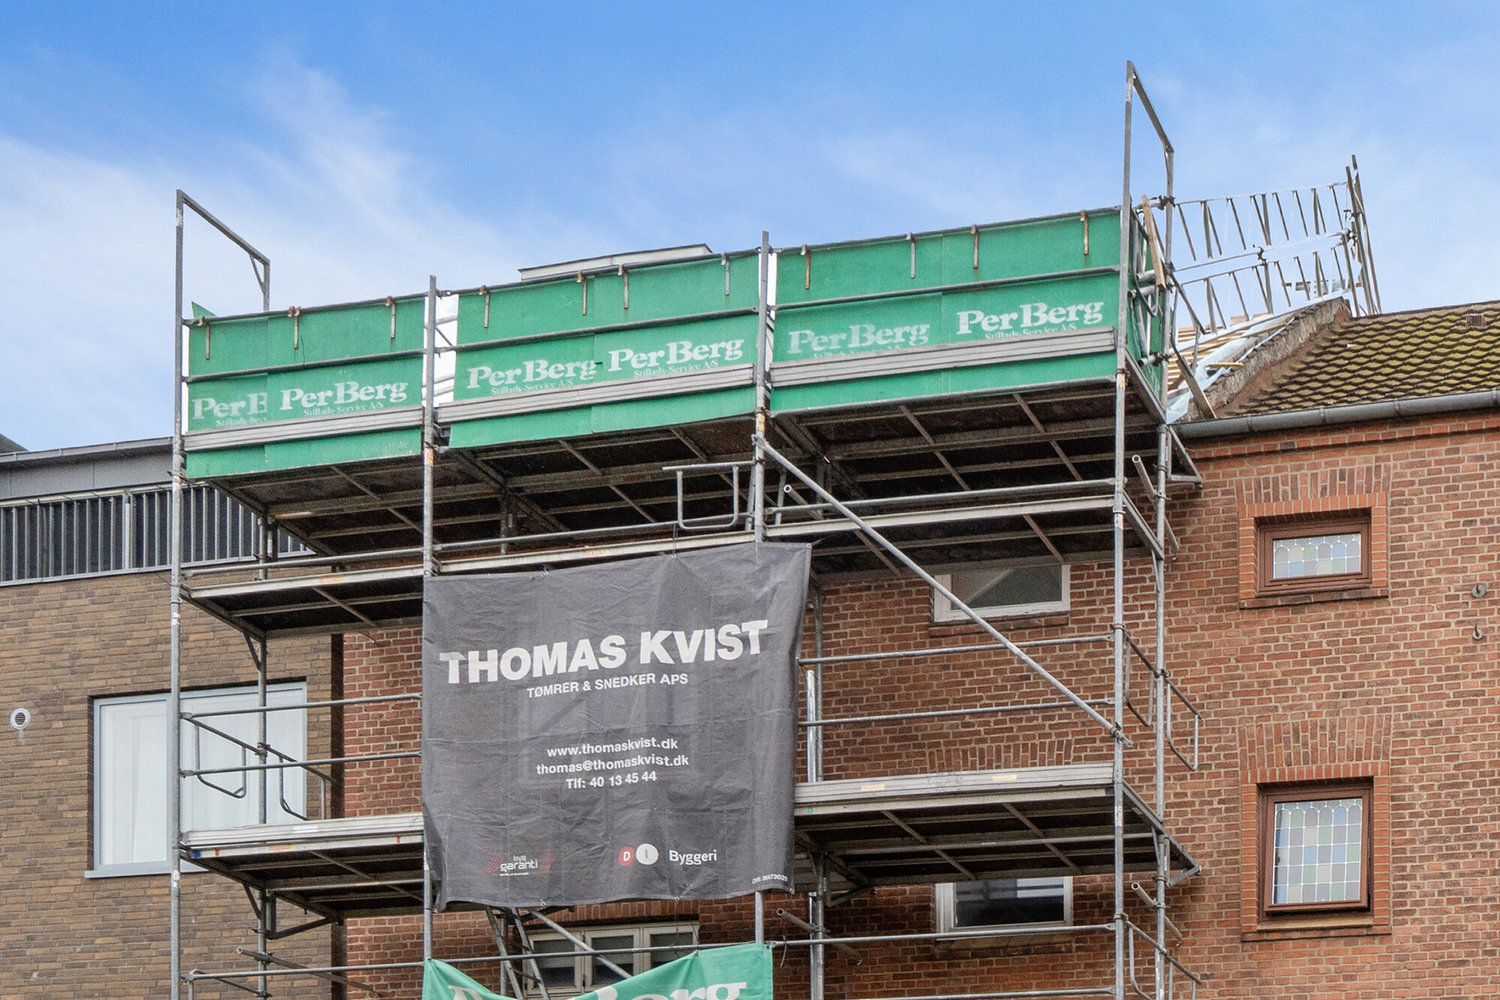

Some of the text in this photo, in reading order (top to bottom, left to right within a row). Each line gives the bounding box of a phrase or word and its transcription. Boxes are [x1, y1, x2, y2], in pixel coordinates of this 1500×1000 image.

[956, 301, 1104, 335] Per Berg
[788, 329, 848, 354] Per
[848, 322, 931, 349] Berg
[607, 339, 744, 373] Per Berg
[467, 365, 522, 389] Per
[191, 397, 246, 420] Per
[279, 381, 409, 411] Per Berg
[439, 619, 768, 684] THOMAS KVIST
[526, 673, 689, 699] TØMRER & SNEDKER APS
[546, 736, 679, 758] www.thomaskvist.dk
[536, 753, 690, 775] thomas@thomaskvist.dk
[565, 770, 658, 790] Tlf: 40 13 45 44
[668, 849, 718, 866] Byggeri
